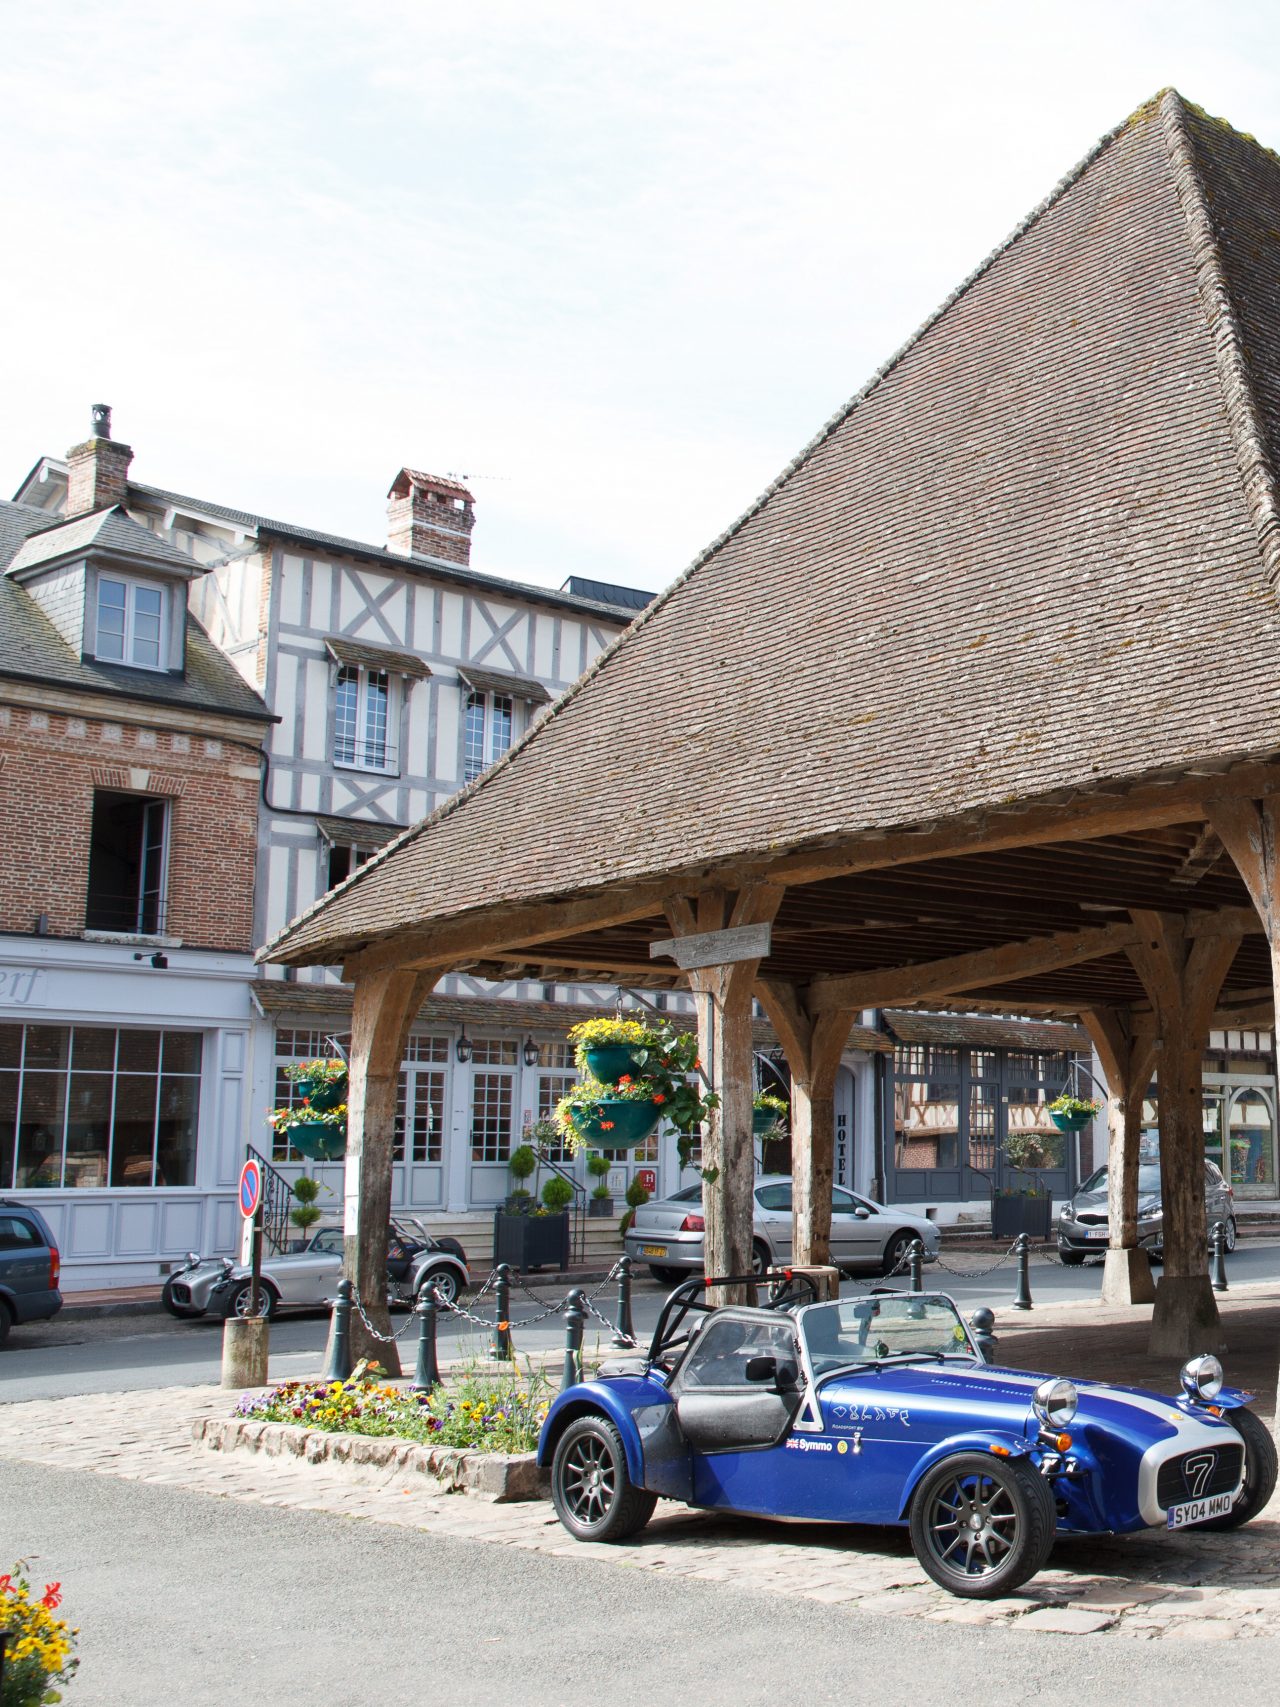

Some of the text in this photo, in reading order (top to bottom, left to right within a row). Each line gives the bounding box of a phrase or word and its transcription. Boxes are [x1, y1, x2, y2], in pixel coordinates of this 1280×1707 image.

[837, 1114, 847, 1185] HOTEL
[646, 1174, 654, 1183] H
[799, 1438, 833, 1452] Symmo
[1186, 1454, 1214, 1497] 7
[1176, 1495, 1231, 1524] SY04 MMO
